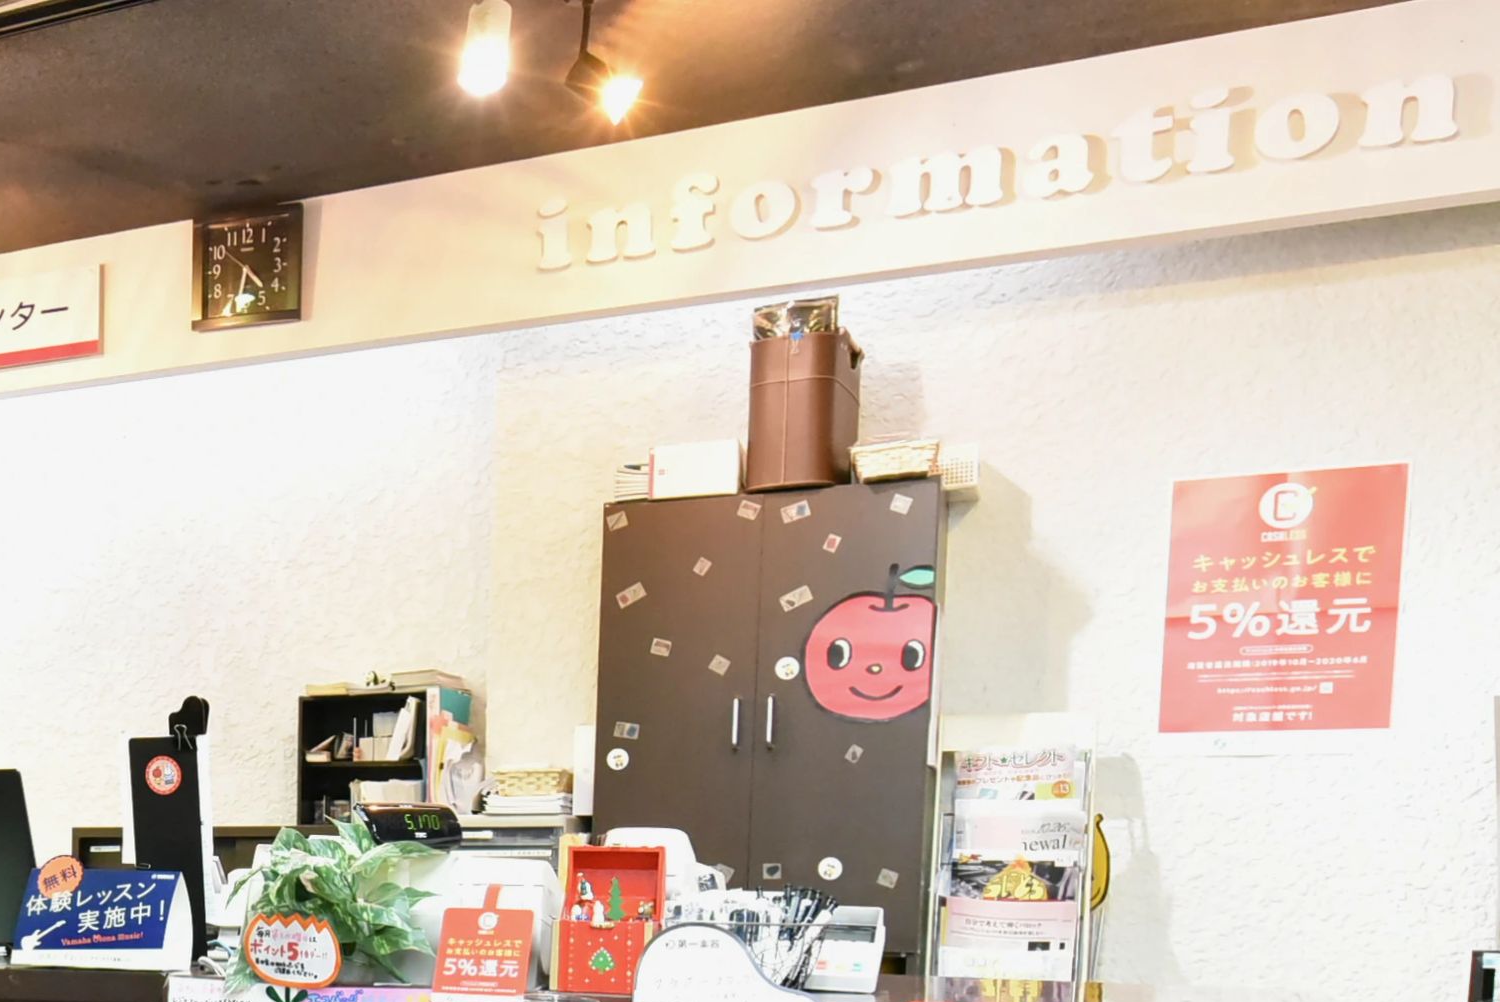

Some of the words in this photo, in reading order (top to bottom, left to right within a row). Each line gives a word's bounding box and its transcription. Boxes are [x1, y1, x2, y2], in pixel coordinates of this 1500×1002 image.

[536, 72, 1460, 272] information
[227, 231, 237, 247] 11
[242, 228, 253, 244] 12
[213, 244, 226, 260] 10
[272, 236, 281, 253] 2
[212, 264, 221, 279] 9
[273, 256, 282, 273] 3
[213, 283, 222, 299] 8
[270, 277, 279, 292] 4
[257, 290, 266, 305] 5
[1192, 545, 1376, 572] キャッシュレスで
[1191, 571, 1373, 594] お支払いのお客様に
[1187, 597, 1372, 640] 5%還元
[43, 863, 78, 892] 無料
[25, 882, 157, 917] 体験レッスン
[61, 937, 92, 947] Yamaha
[117, 931, 144, 941] Music!
[447, 937, 523, 948] キャッシュレスで
[442, 957, 520, 978] 5%還元
